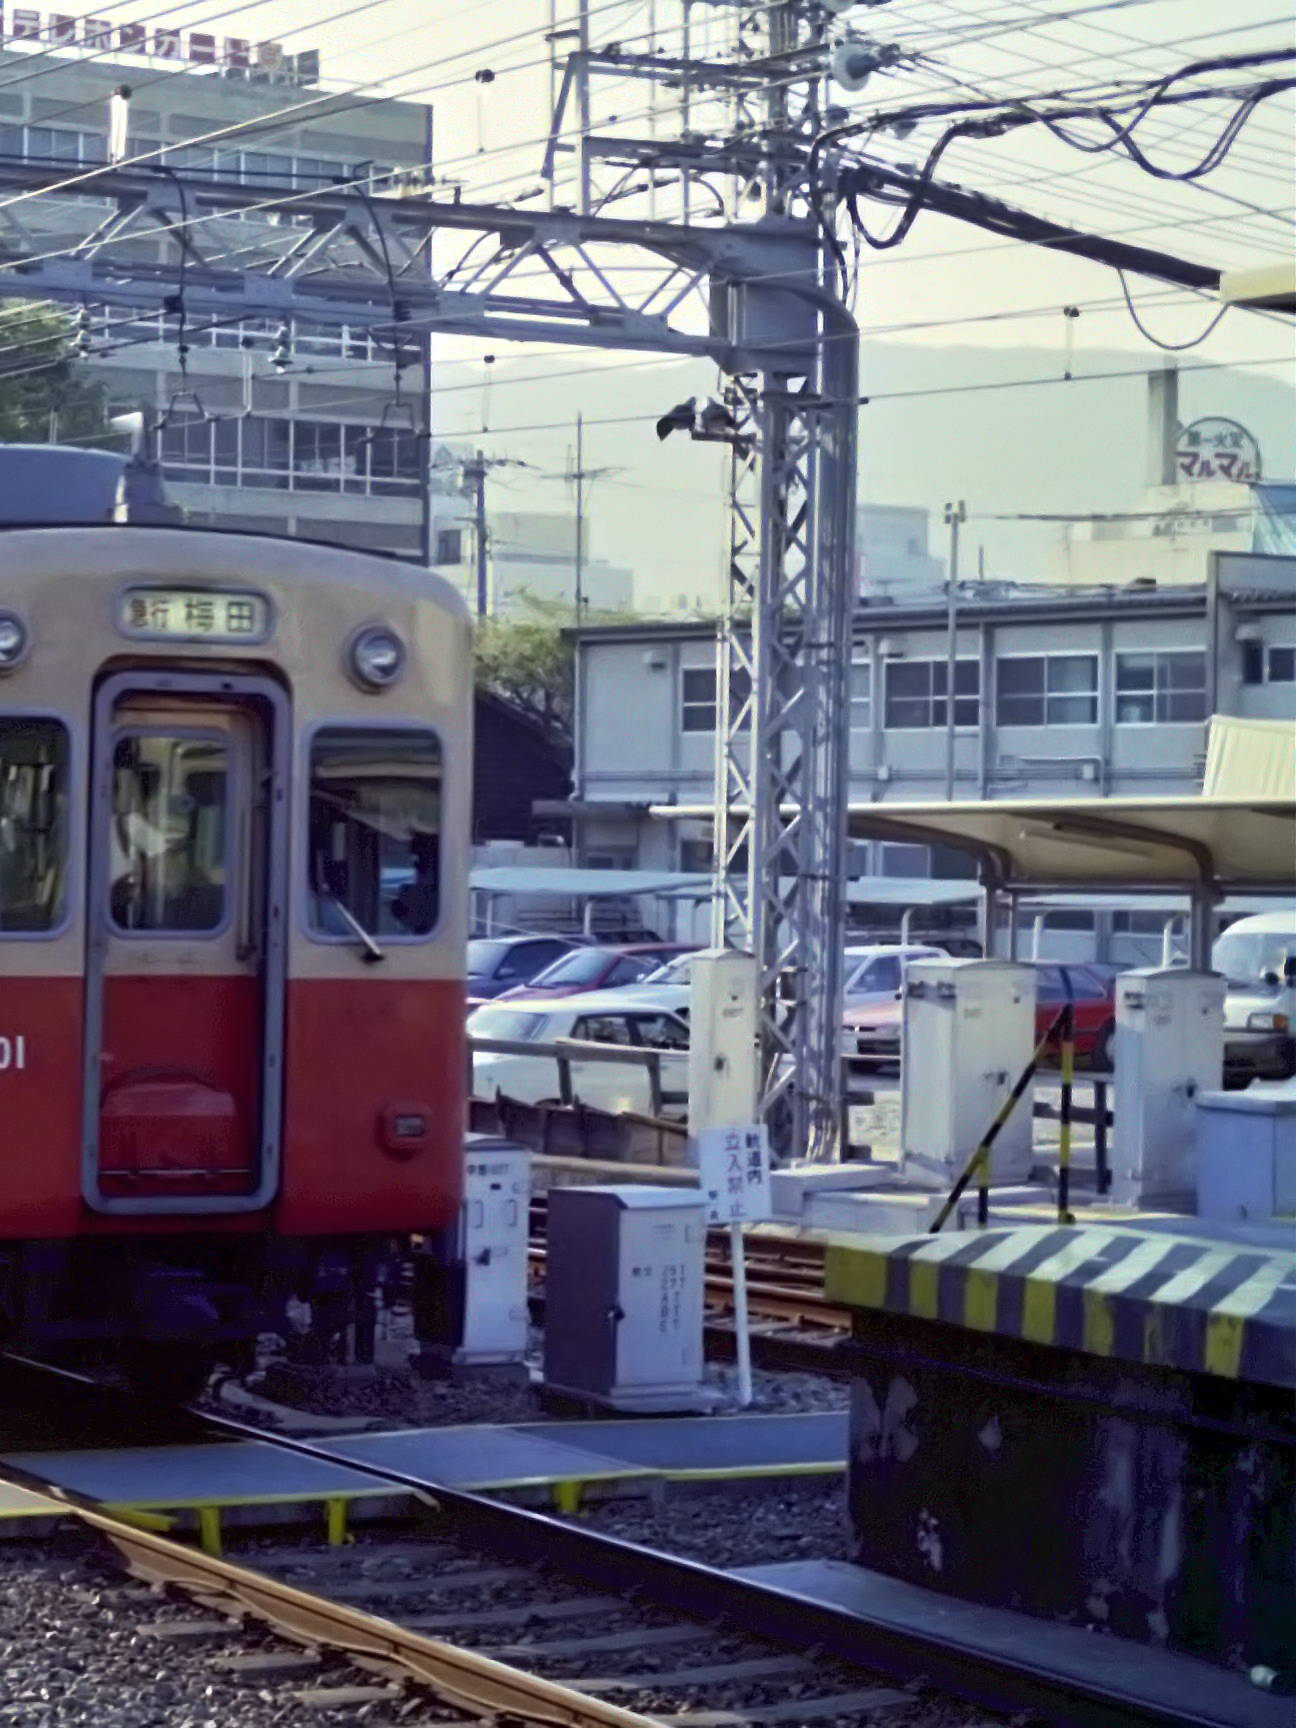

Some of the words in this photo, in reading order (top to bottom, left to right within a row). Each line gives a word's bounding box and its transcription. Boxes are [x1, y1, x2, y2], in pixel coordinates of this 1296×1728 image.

[131, 599, 170, 628] 急行
[185, 598, 254, 632] 梅田
[725, 1131, 747, 1217] 立入禁止
